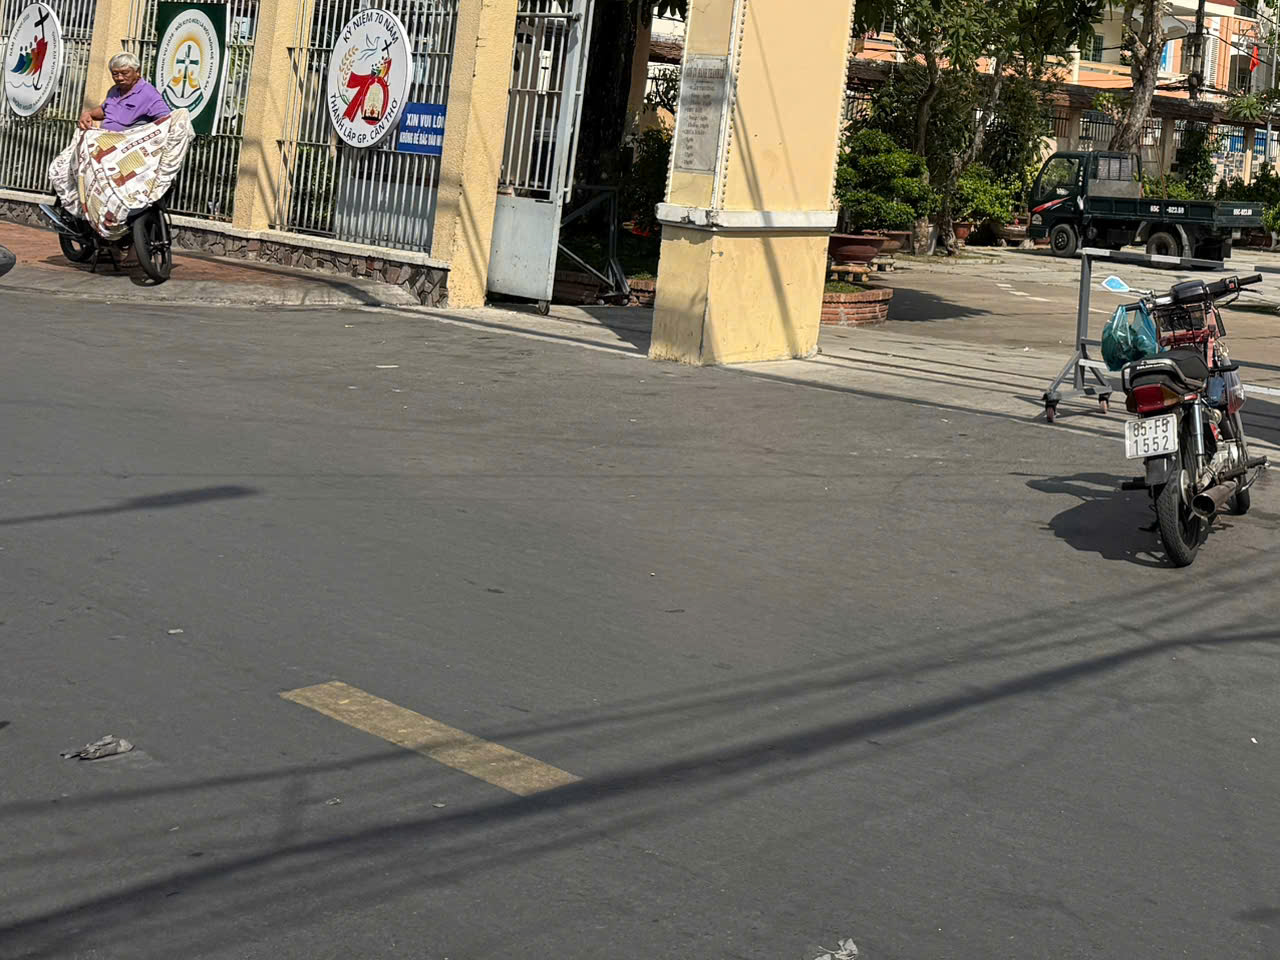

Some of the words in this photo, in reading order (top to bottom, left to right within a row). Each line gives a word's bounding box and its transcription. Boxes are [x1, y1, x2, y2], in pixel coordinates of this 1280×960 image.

[375, 13, 384, 24] 70
[384, 19, 398, 44] NĂM
[330, 92, 345, 132] THÀNH
[342, 71, 390, 125] 70
[405, 113, 419, 126] XIN
[420, 114, 432, 127] VUI
[1133, 435, 1169, 456] 1552
